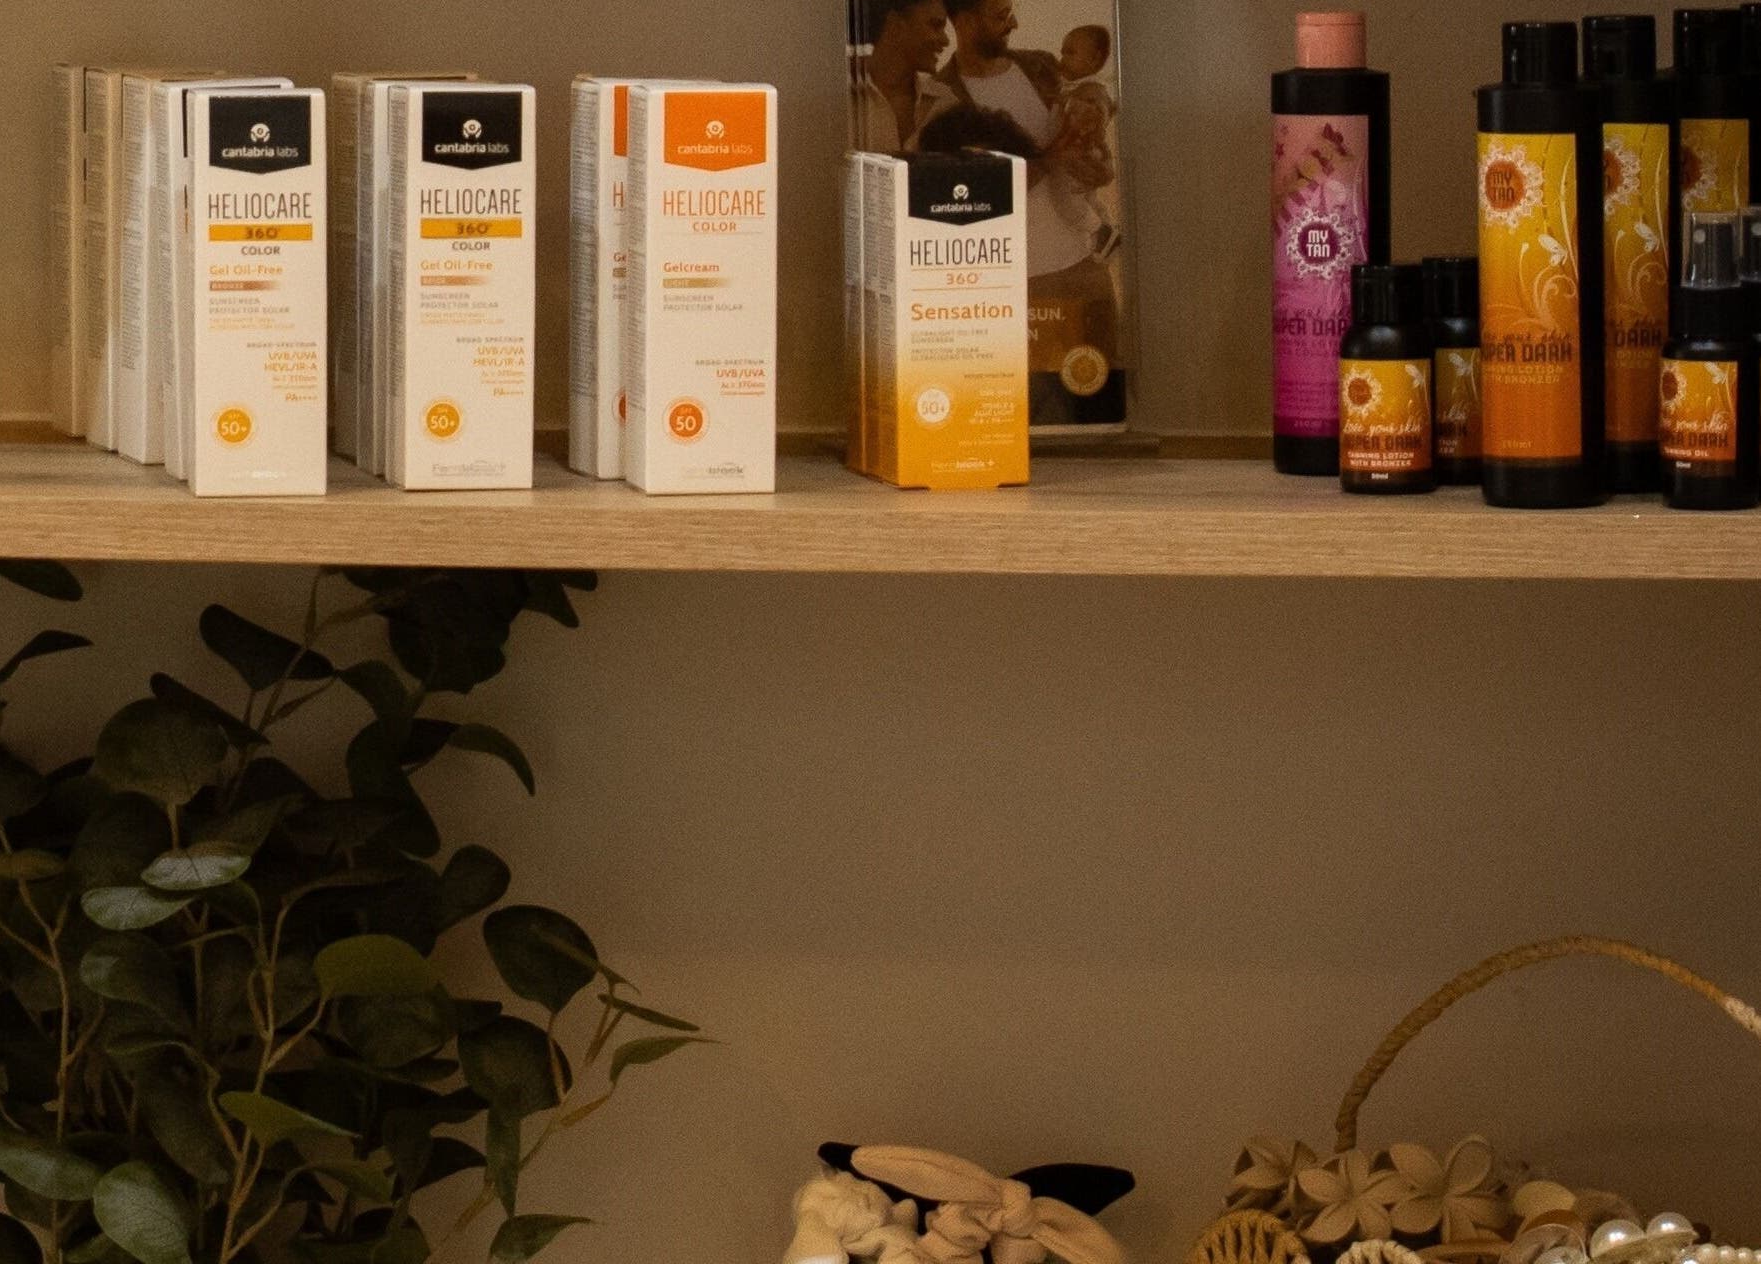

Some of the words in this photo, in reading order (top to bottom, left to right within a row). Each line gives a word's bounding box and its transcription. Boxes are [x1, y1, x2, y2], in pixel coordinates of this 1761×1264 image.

[221, 145, 275, 158] cantabria
[276, 145, 299, 158] labs
[435, 141, 487, 154] cantabria
[488, 141, 510, 154] labs
[677, 142, 729, 155] cantabria
[731, 141, 753, 154] labs
[1489, 173, 1513, 187] MY
[1489, 186, 1516, 201] TAN
[207, 193, 313, 219] HELIOCARE
[419, 188, 523, 215] HELIOCARE
[663, 190, 766, 216] HELIOCARE
[930, 203, 973, 213] cantabria
[974, 202, 991, 212] labs
[693, 222, 737, 232] COLOR
[1308, 230, 1329, 244] MY
[241, 246, 281, 256] COLOR
[451, 241, 491, 251] COLOR
[910, 237, 1012, 266] HELIOCARE
[1306, 243, 1331, 257] TAN
[209, 264, 229, 275] Gel
[233, 264, 284, 275] Oil-Free
[420, 260, 440, 271] Gel
[443, 260, 493, 271] Oil-Free
[663, 262, 720, 273] Gelcream
[911, 302, 1013, 321] Sensation
[1312, 318, 1348, 336] DAR
[1522, 343, 1572, 362] DARK
[675, 416, 697, 431] 50
